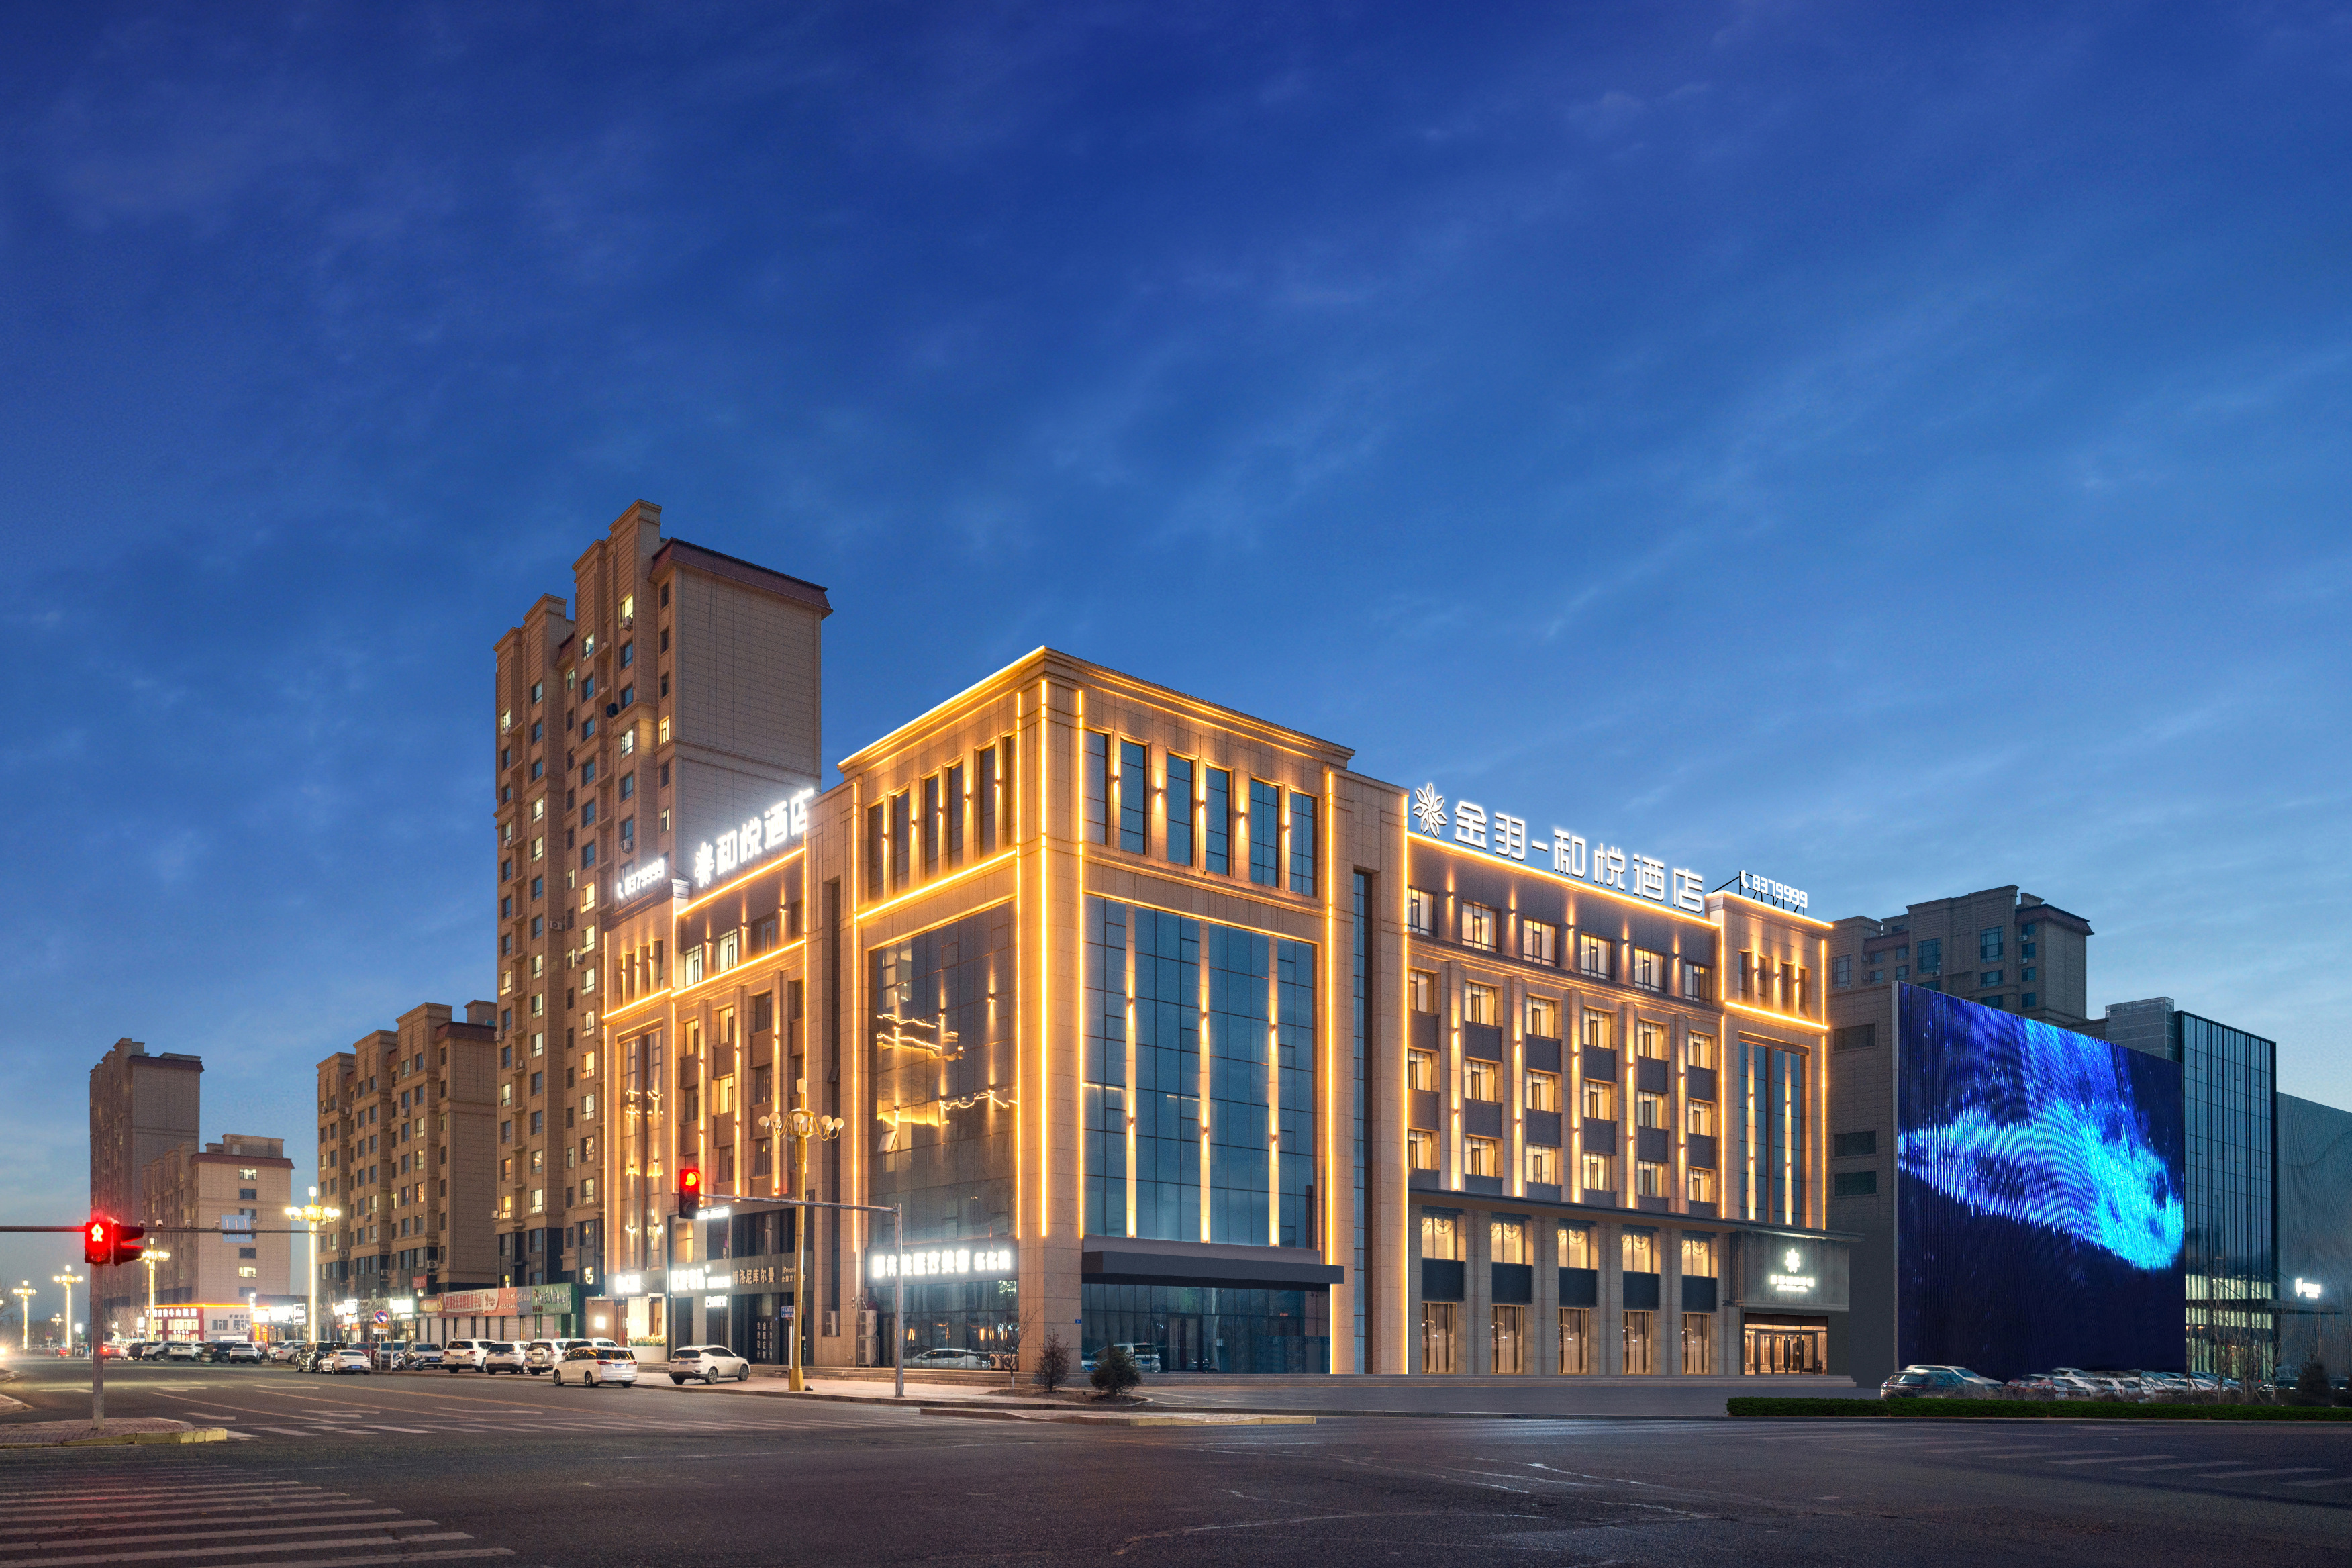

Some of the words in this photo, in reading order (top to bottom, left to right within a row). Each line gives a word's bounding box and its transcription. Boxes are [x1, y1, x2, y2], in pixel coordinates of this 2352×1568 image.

[716, 788, 814, 875] 和悦酒店
[1752, 873, 1808, 908] 8379999
[732, 1267, 775, 1285] 博洛尼库尔曼
